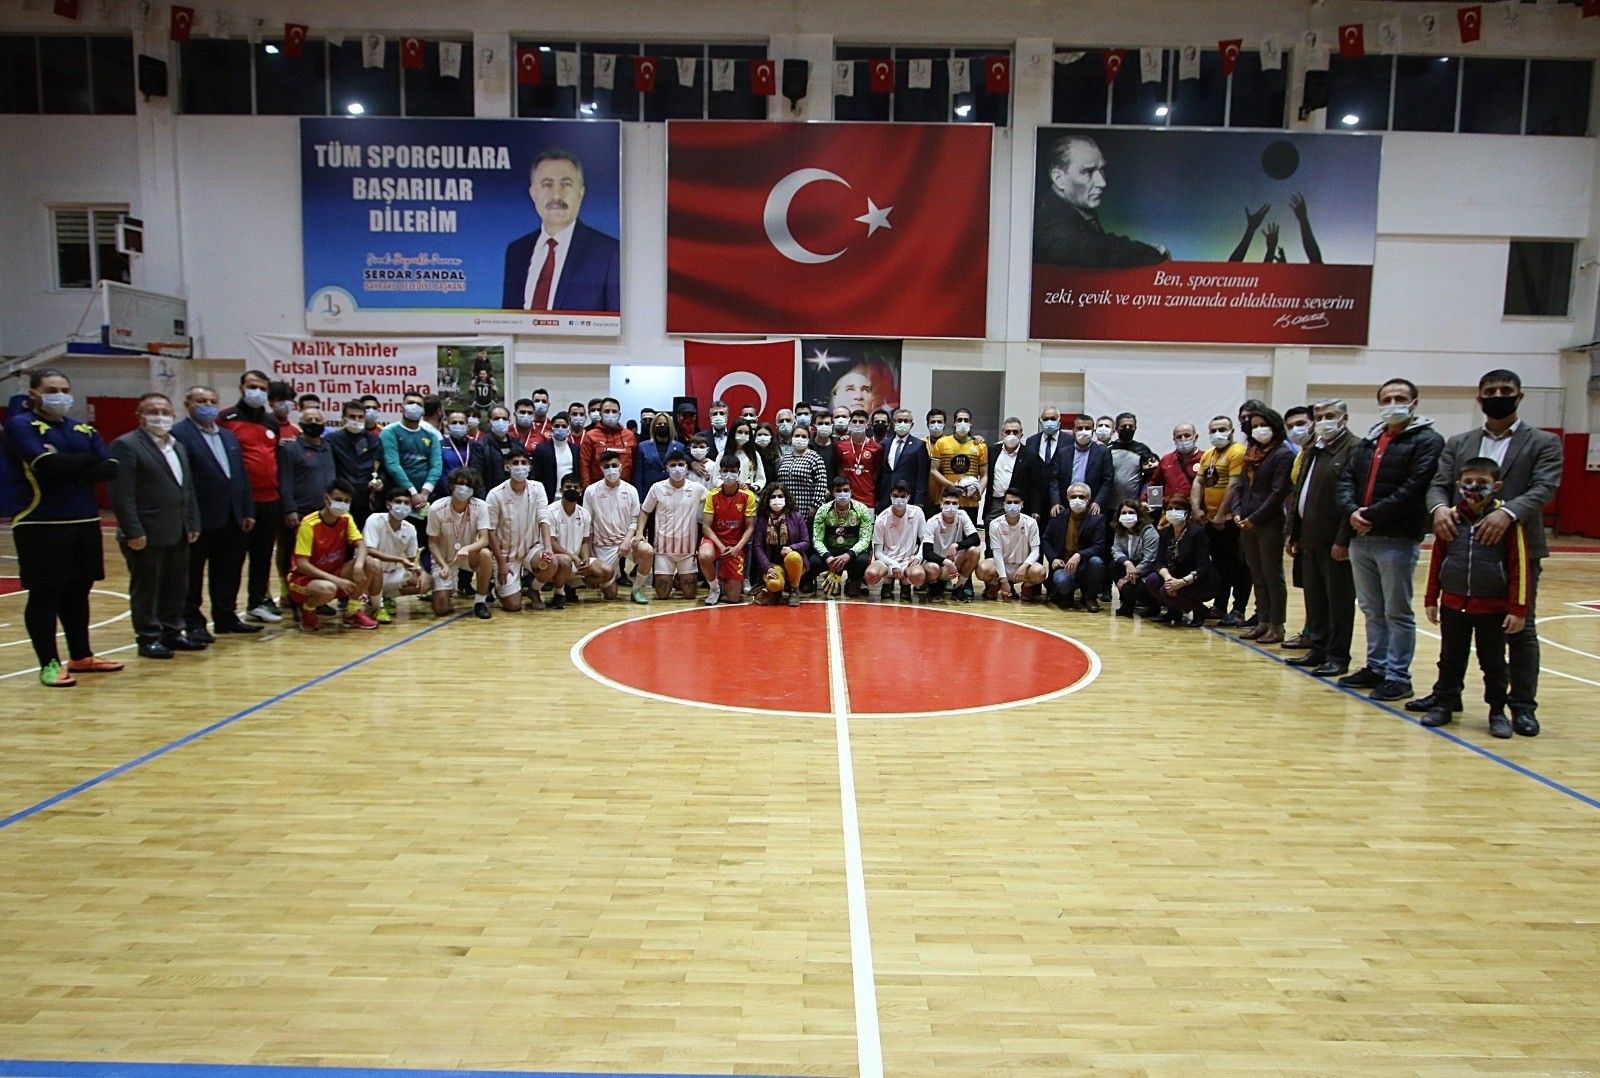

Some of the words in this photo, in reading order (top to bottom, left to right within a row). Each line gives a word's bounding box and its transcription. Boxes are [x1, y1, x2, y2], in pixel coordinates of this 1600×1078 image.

[314, 141, 362, 168] TÜM
[367, 145, 511, 170] SPORCULARA
[352, 176, 474, 205] BAŞARILAR
[369, 205, 457, 233] DİLERİM
[364, 269, 412, 280] SERDAR
[416, 270, 465, 280] SANDAL
[1153, 270, 1183, 288] Ben,
[1187, 274, 1259, 290] sporcunun
[1044, 288, 1075, 306] zeki,
[1078, 289, 1113, 307] çevik
[1116, 294, 1130, 305] ve
[1132, 294, 1160, 309] aynı
[1164, 292, 1228, 308] zamanda
[1230, 292, 1301, 309] ahlaklısını
[1302, 295, 1354, 310] severim
[291, 341, 335, 356] Malik
[338, 342, 399, 357] Tahirler
[273, 359, 318, 375] Futsal
[322, 361, 417, 377] Turnuvasına
[319, 379, 351, 393] Tüm
[355, 380, 431, 395] Takımlara
[477, 386, 489, 397] 10
